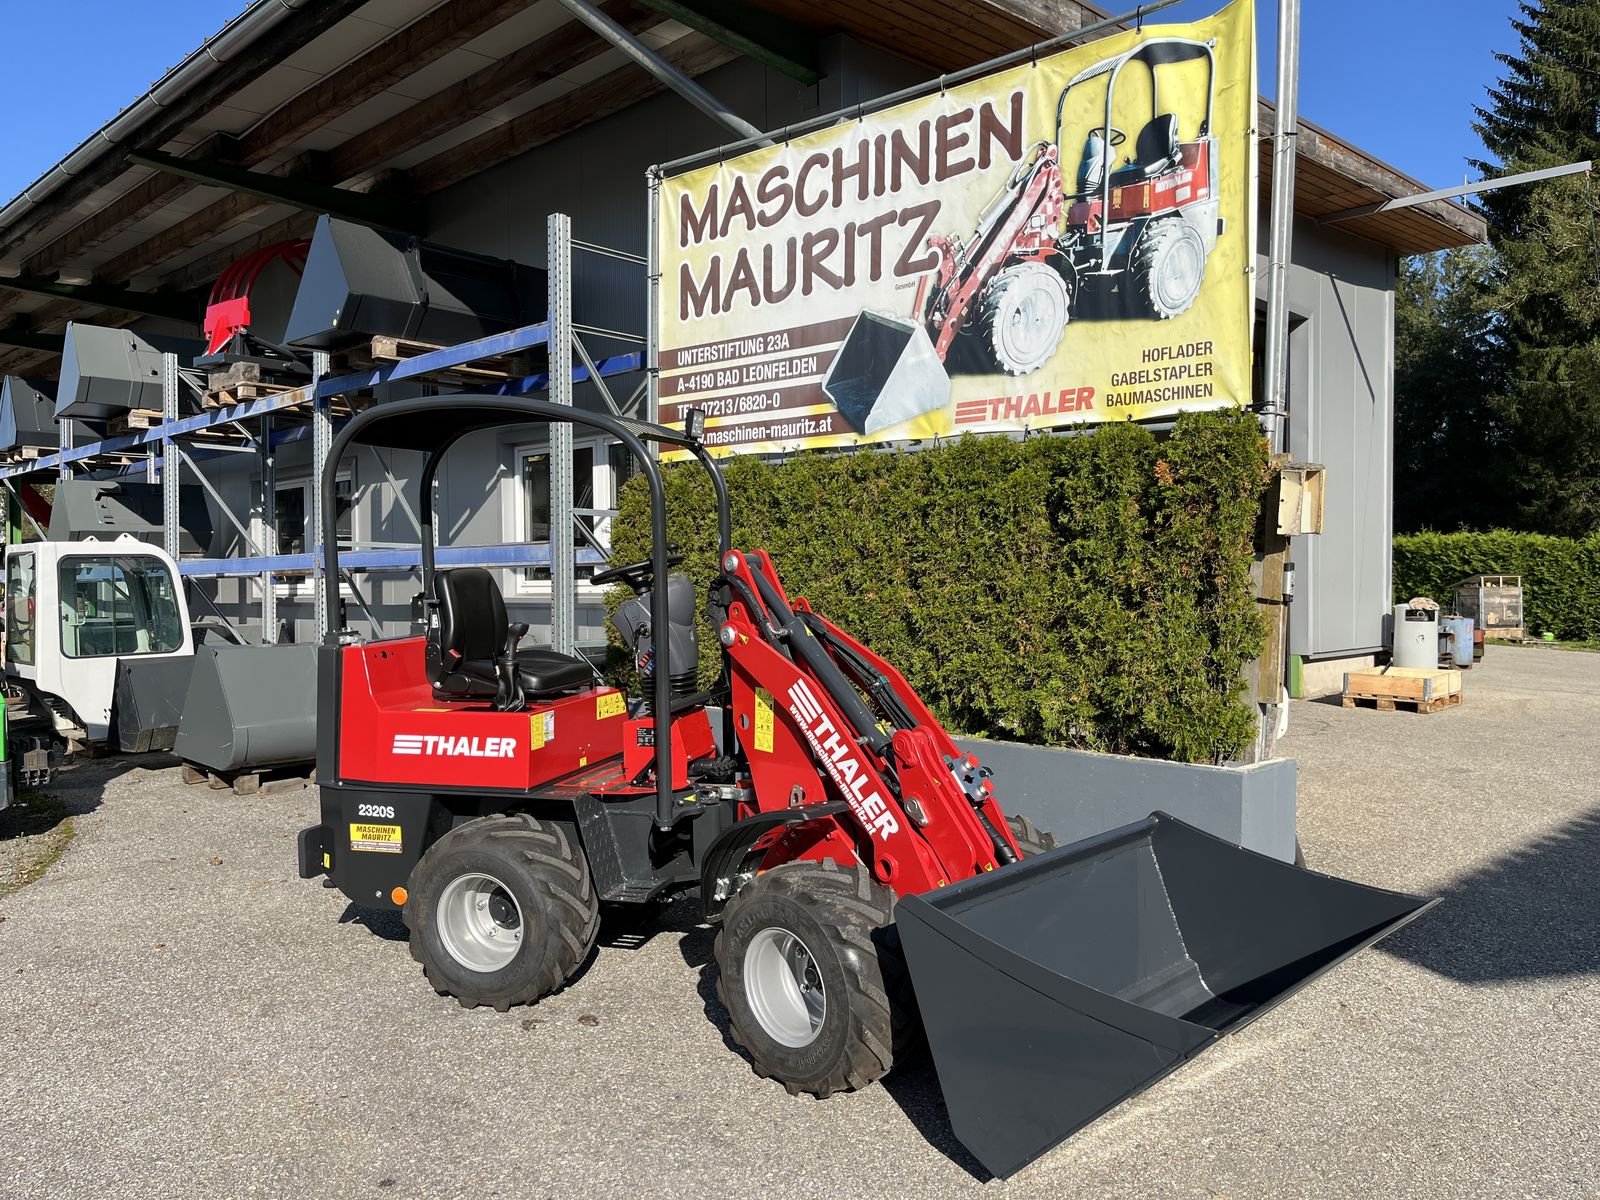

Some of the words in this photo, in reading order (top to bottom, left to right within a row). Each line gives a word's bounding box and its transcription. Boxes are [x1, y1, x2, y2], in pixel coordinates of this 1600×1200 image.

[680, 91, 1024, 248] MASCHINEN
[680, 200, 941, 321] MAURITZ
[677, 337, 764, 366] UNTERSTIFTUNG
[767, 333, 790, 352] 23A
[1142, 340, 1213, 363] HOFLADER
[677, 374, 714, 393] A-4190
[717, 369, 740, 387] BAD
[743, 356, 817, 383] LEONFELDEN
[1111, 362, 1213, 387] GABELSTAPLER
[701, 392, 781, 416] 07213/6820-0
[988, 386, 1095, 421] THALER
[1106, 383, 1213, 407] BAUMASCHINEN
[423, 735, 517, 758] THALER
[789, 703, 878, 836] www.maschinen-mauritz.at
[814, 712, 899, 841] THALER
[358, 803, 395, 819] 2320S
[356, 825, 397, 835] MASCHINEN
[361, 833, 392, 841] MAURITZ
